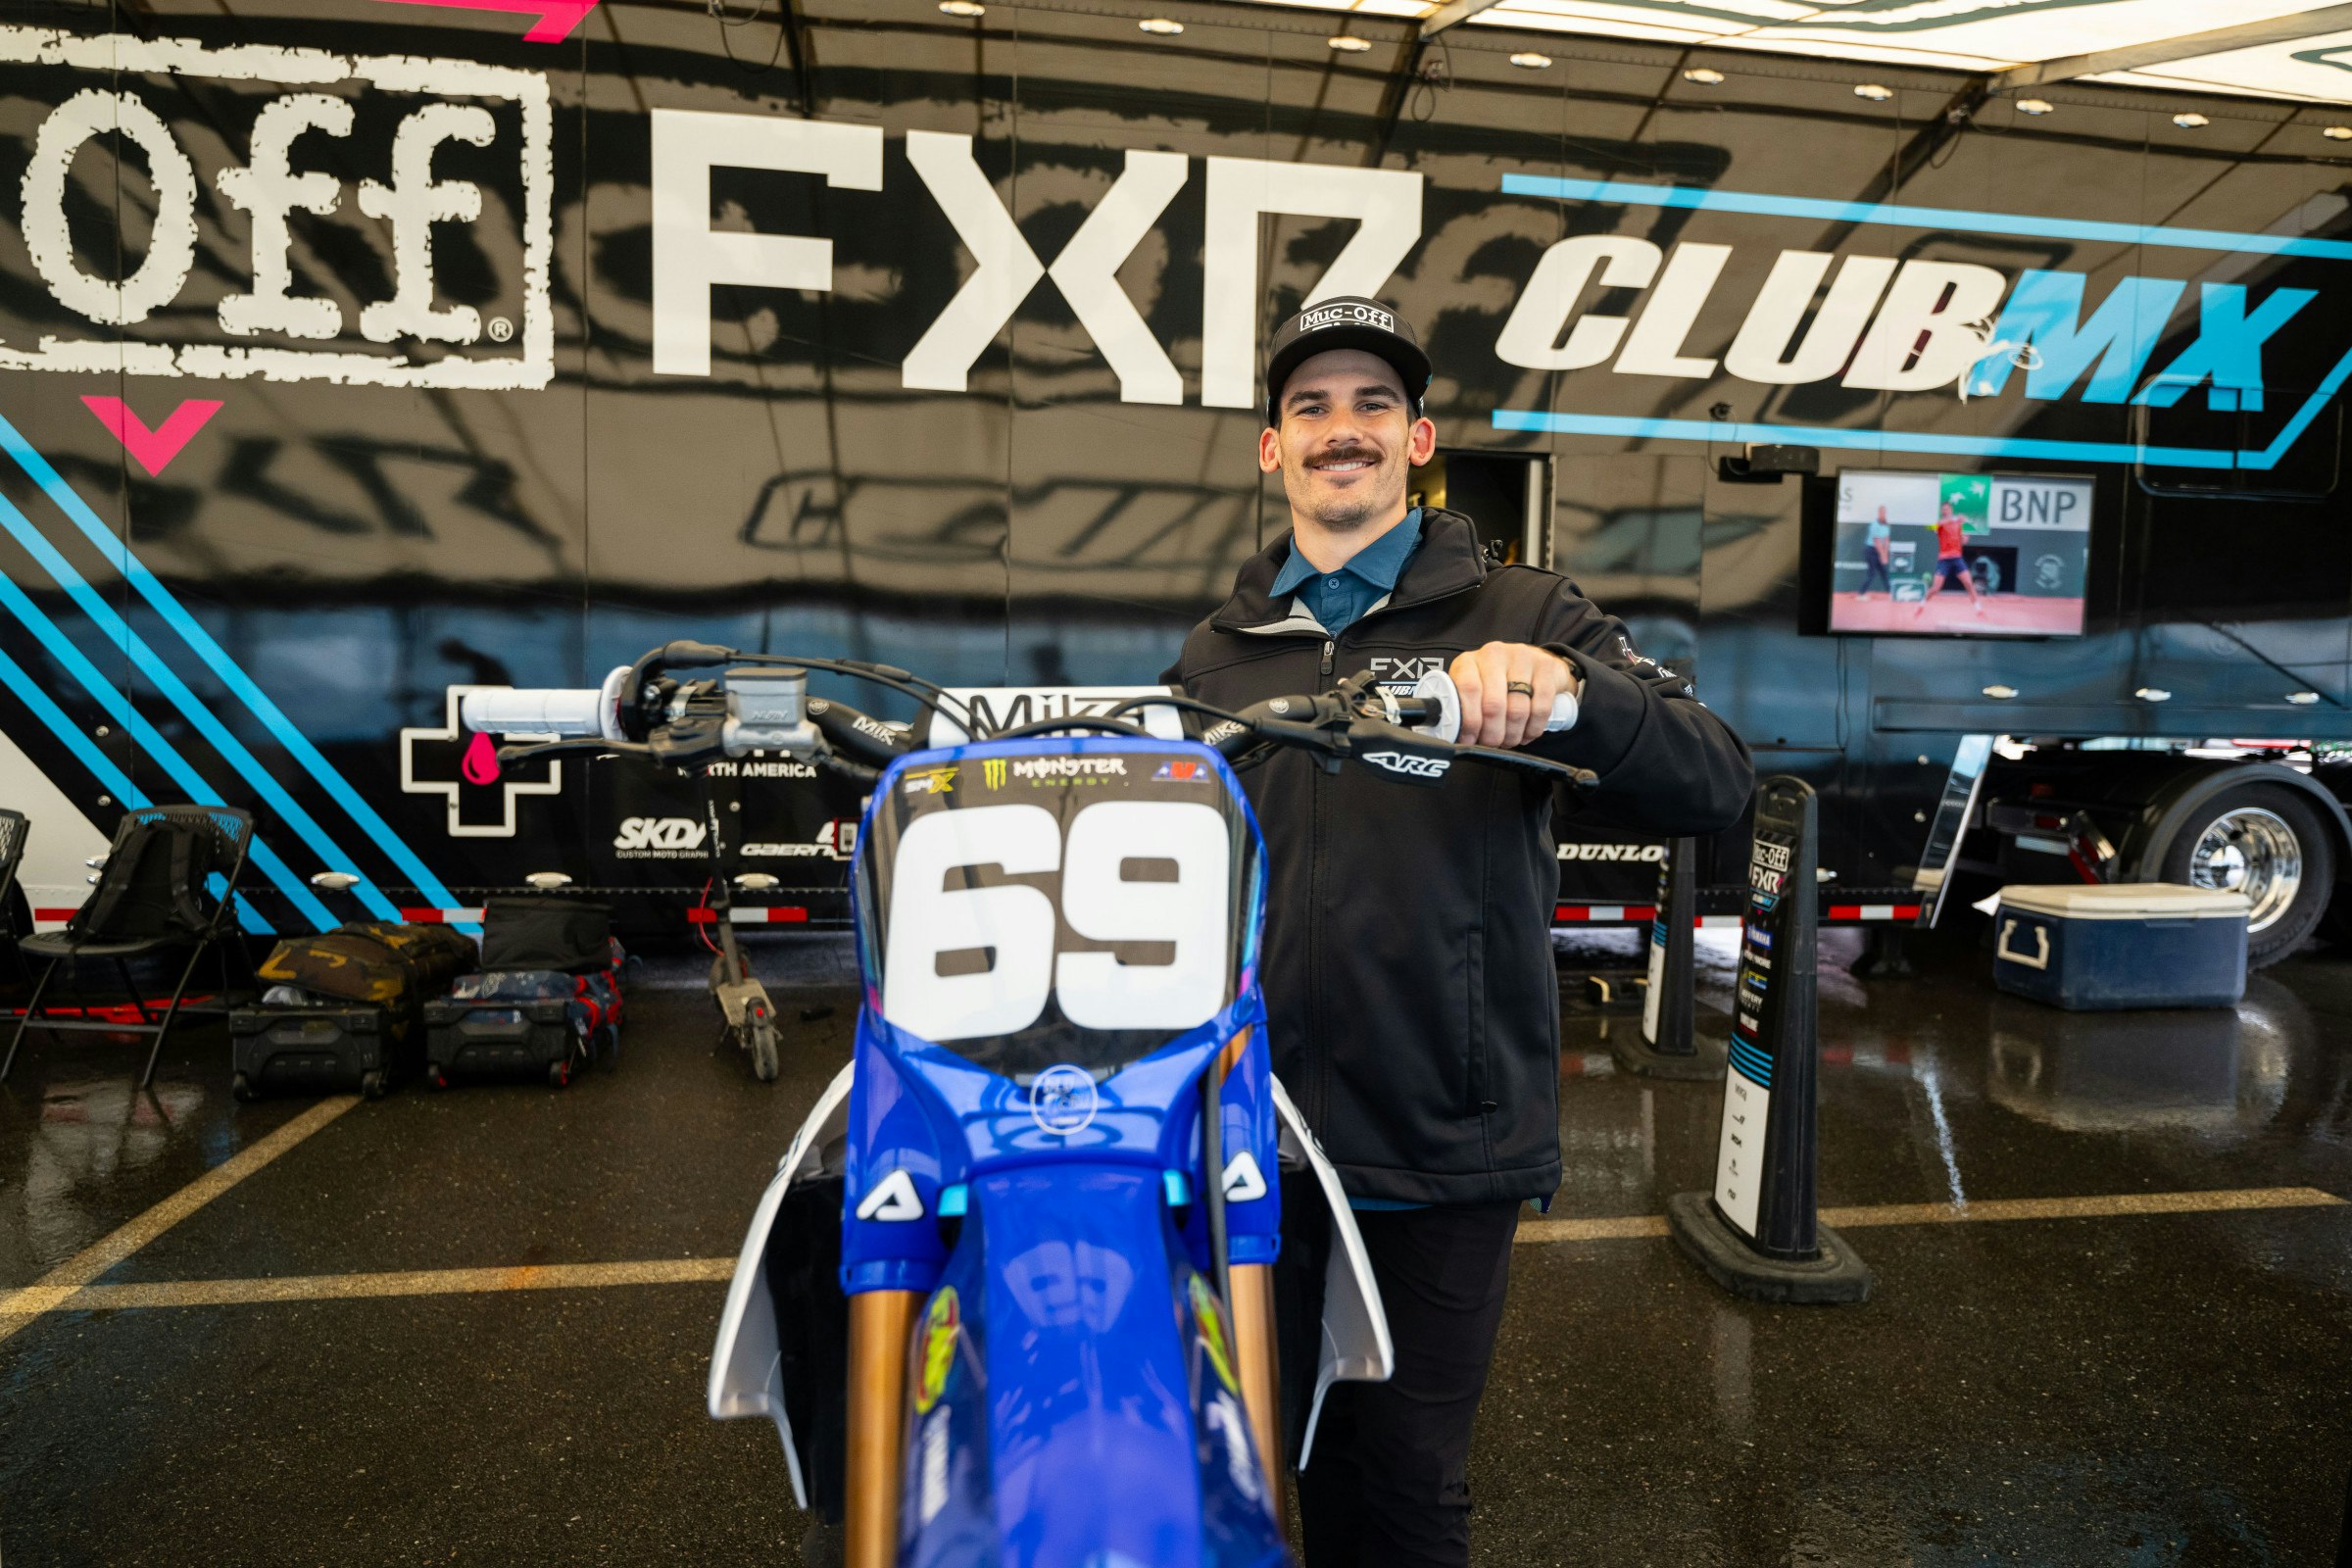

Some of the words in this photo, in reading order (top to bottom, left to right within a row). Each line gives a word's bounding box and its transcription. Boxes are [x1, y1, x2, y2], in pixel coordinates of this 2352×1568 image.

[20, 87, 496, 345] Off
[1303, 306, 1390, 328] Muc-Off
[1494, 234, 2320, 412] CLUBMX
[1999, 488, 2078, 525] BNP
[1370, 657, 1445, 679] FXR
[741, 762, 817, 778] AMERICA
[1362, 751, 1450, 777] ARC
[1031, 777, 1110, 788] ENERGY
[615, 849, 652, 859] CUSTOM
[652, 849, 678, 859] MOTO
[678, 849, 710, 859] GRAPHI
[1556, 843, 1664, 861] DUNLO
[1751, 864, 1781, 895] FXR
[883, 800, 1231, 1041] 69
